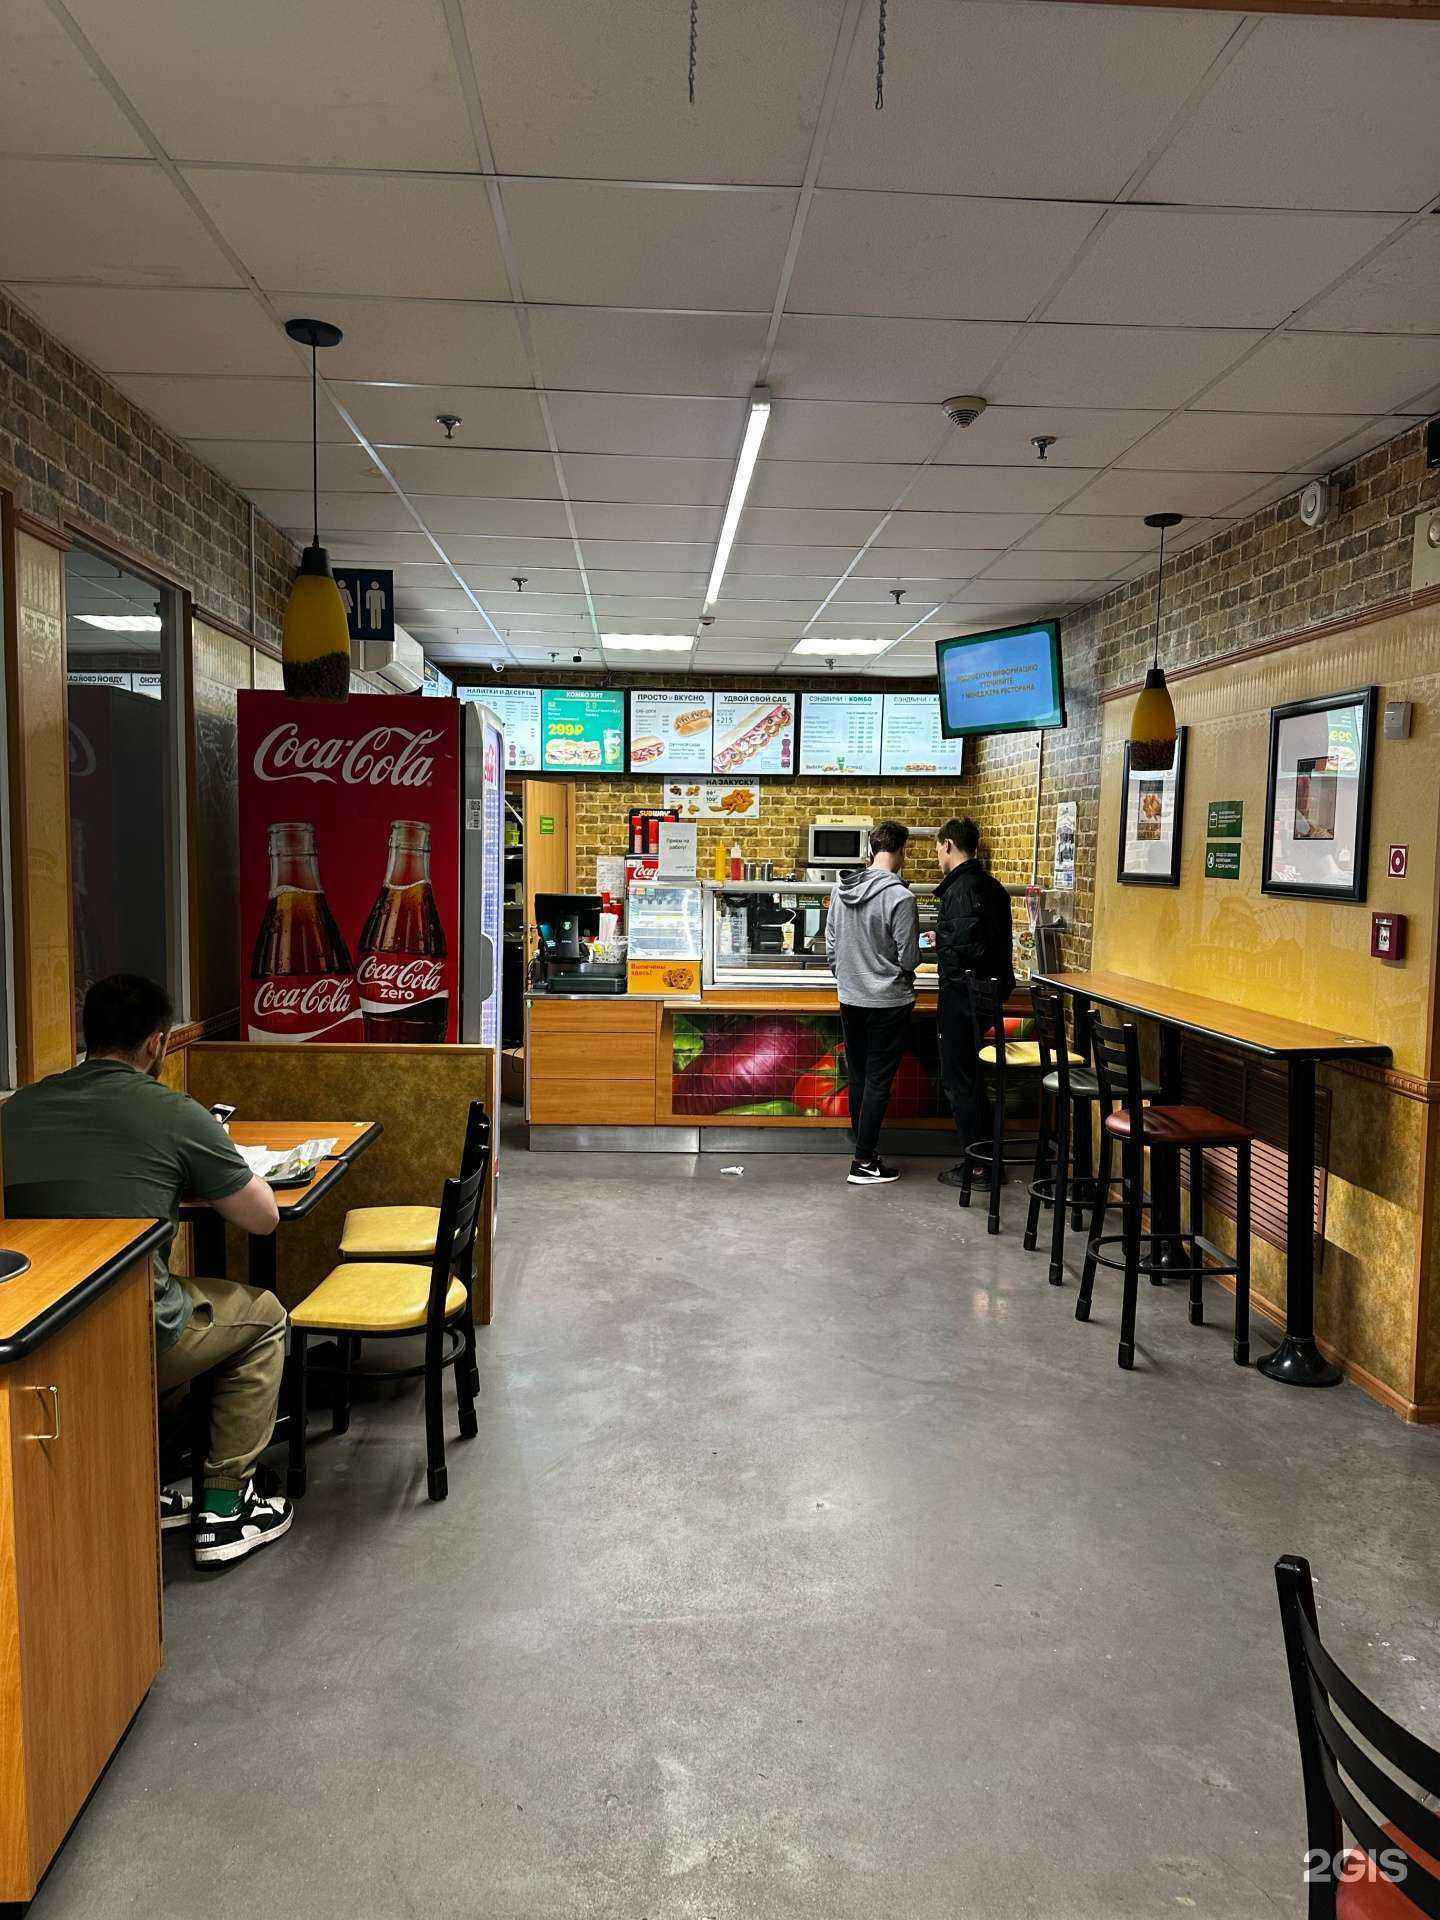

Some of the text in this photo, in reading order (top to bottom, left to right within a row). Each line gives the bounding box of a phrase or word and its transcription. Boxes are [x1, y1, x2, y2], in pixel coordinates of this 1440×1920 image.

[723, 694, 749, 702] УДВОЙ
[750, 694, 771, 702] СВОЙ
[253, 722, 448, 787] Coca-Cola
[357, 955, 445, 991] Coca-Cola
[254, 976, 354, 1016] Coca-Cola
[380, 987, 415, 1000] zero
